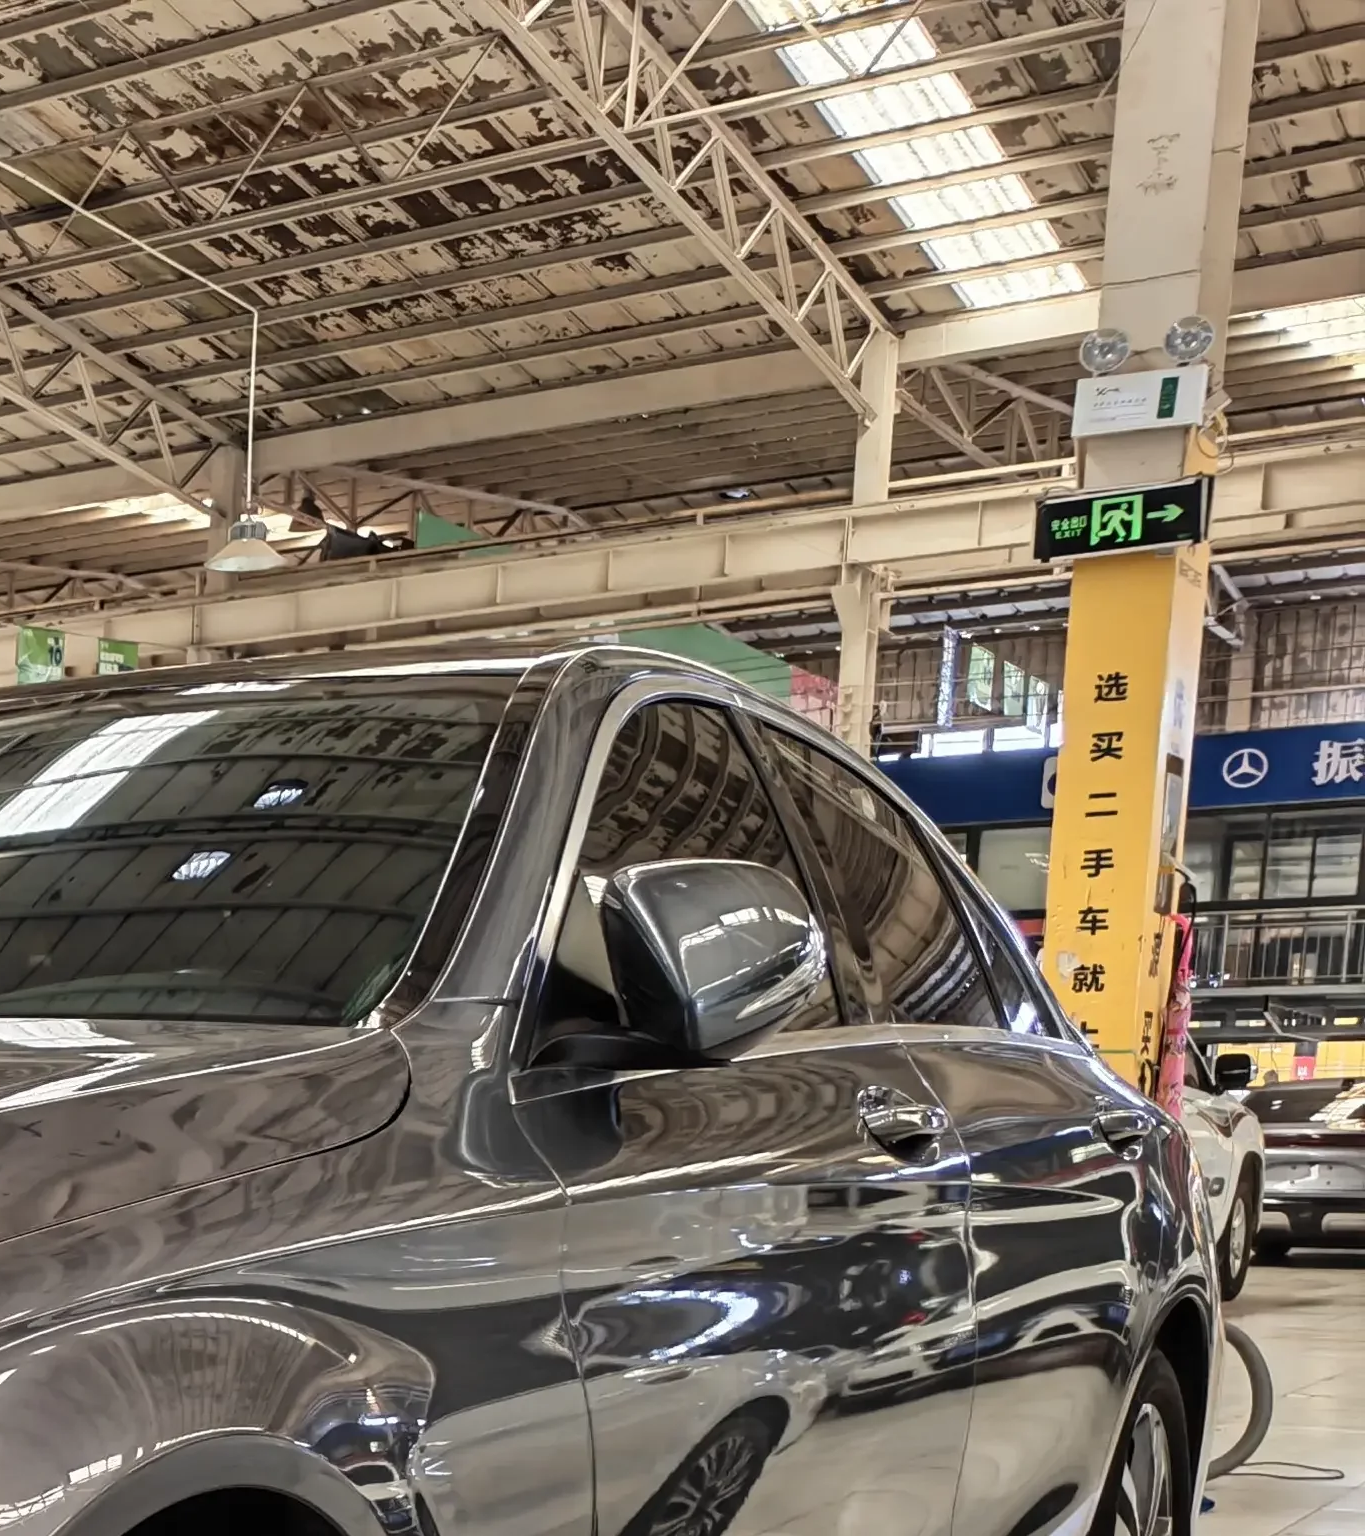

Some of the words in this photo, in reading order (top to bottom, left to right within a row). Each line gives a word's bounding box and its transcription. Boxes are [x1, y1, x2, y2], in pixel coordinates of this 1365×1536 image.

[1050, 515, 1088, 531] 安全出口
[1055, 528, 1083, 540] EXIT
[1311, 738, 1365, 786] 振
